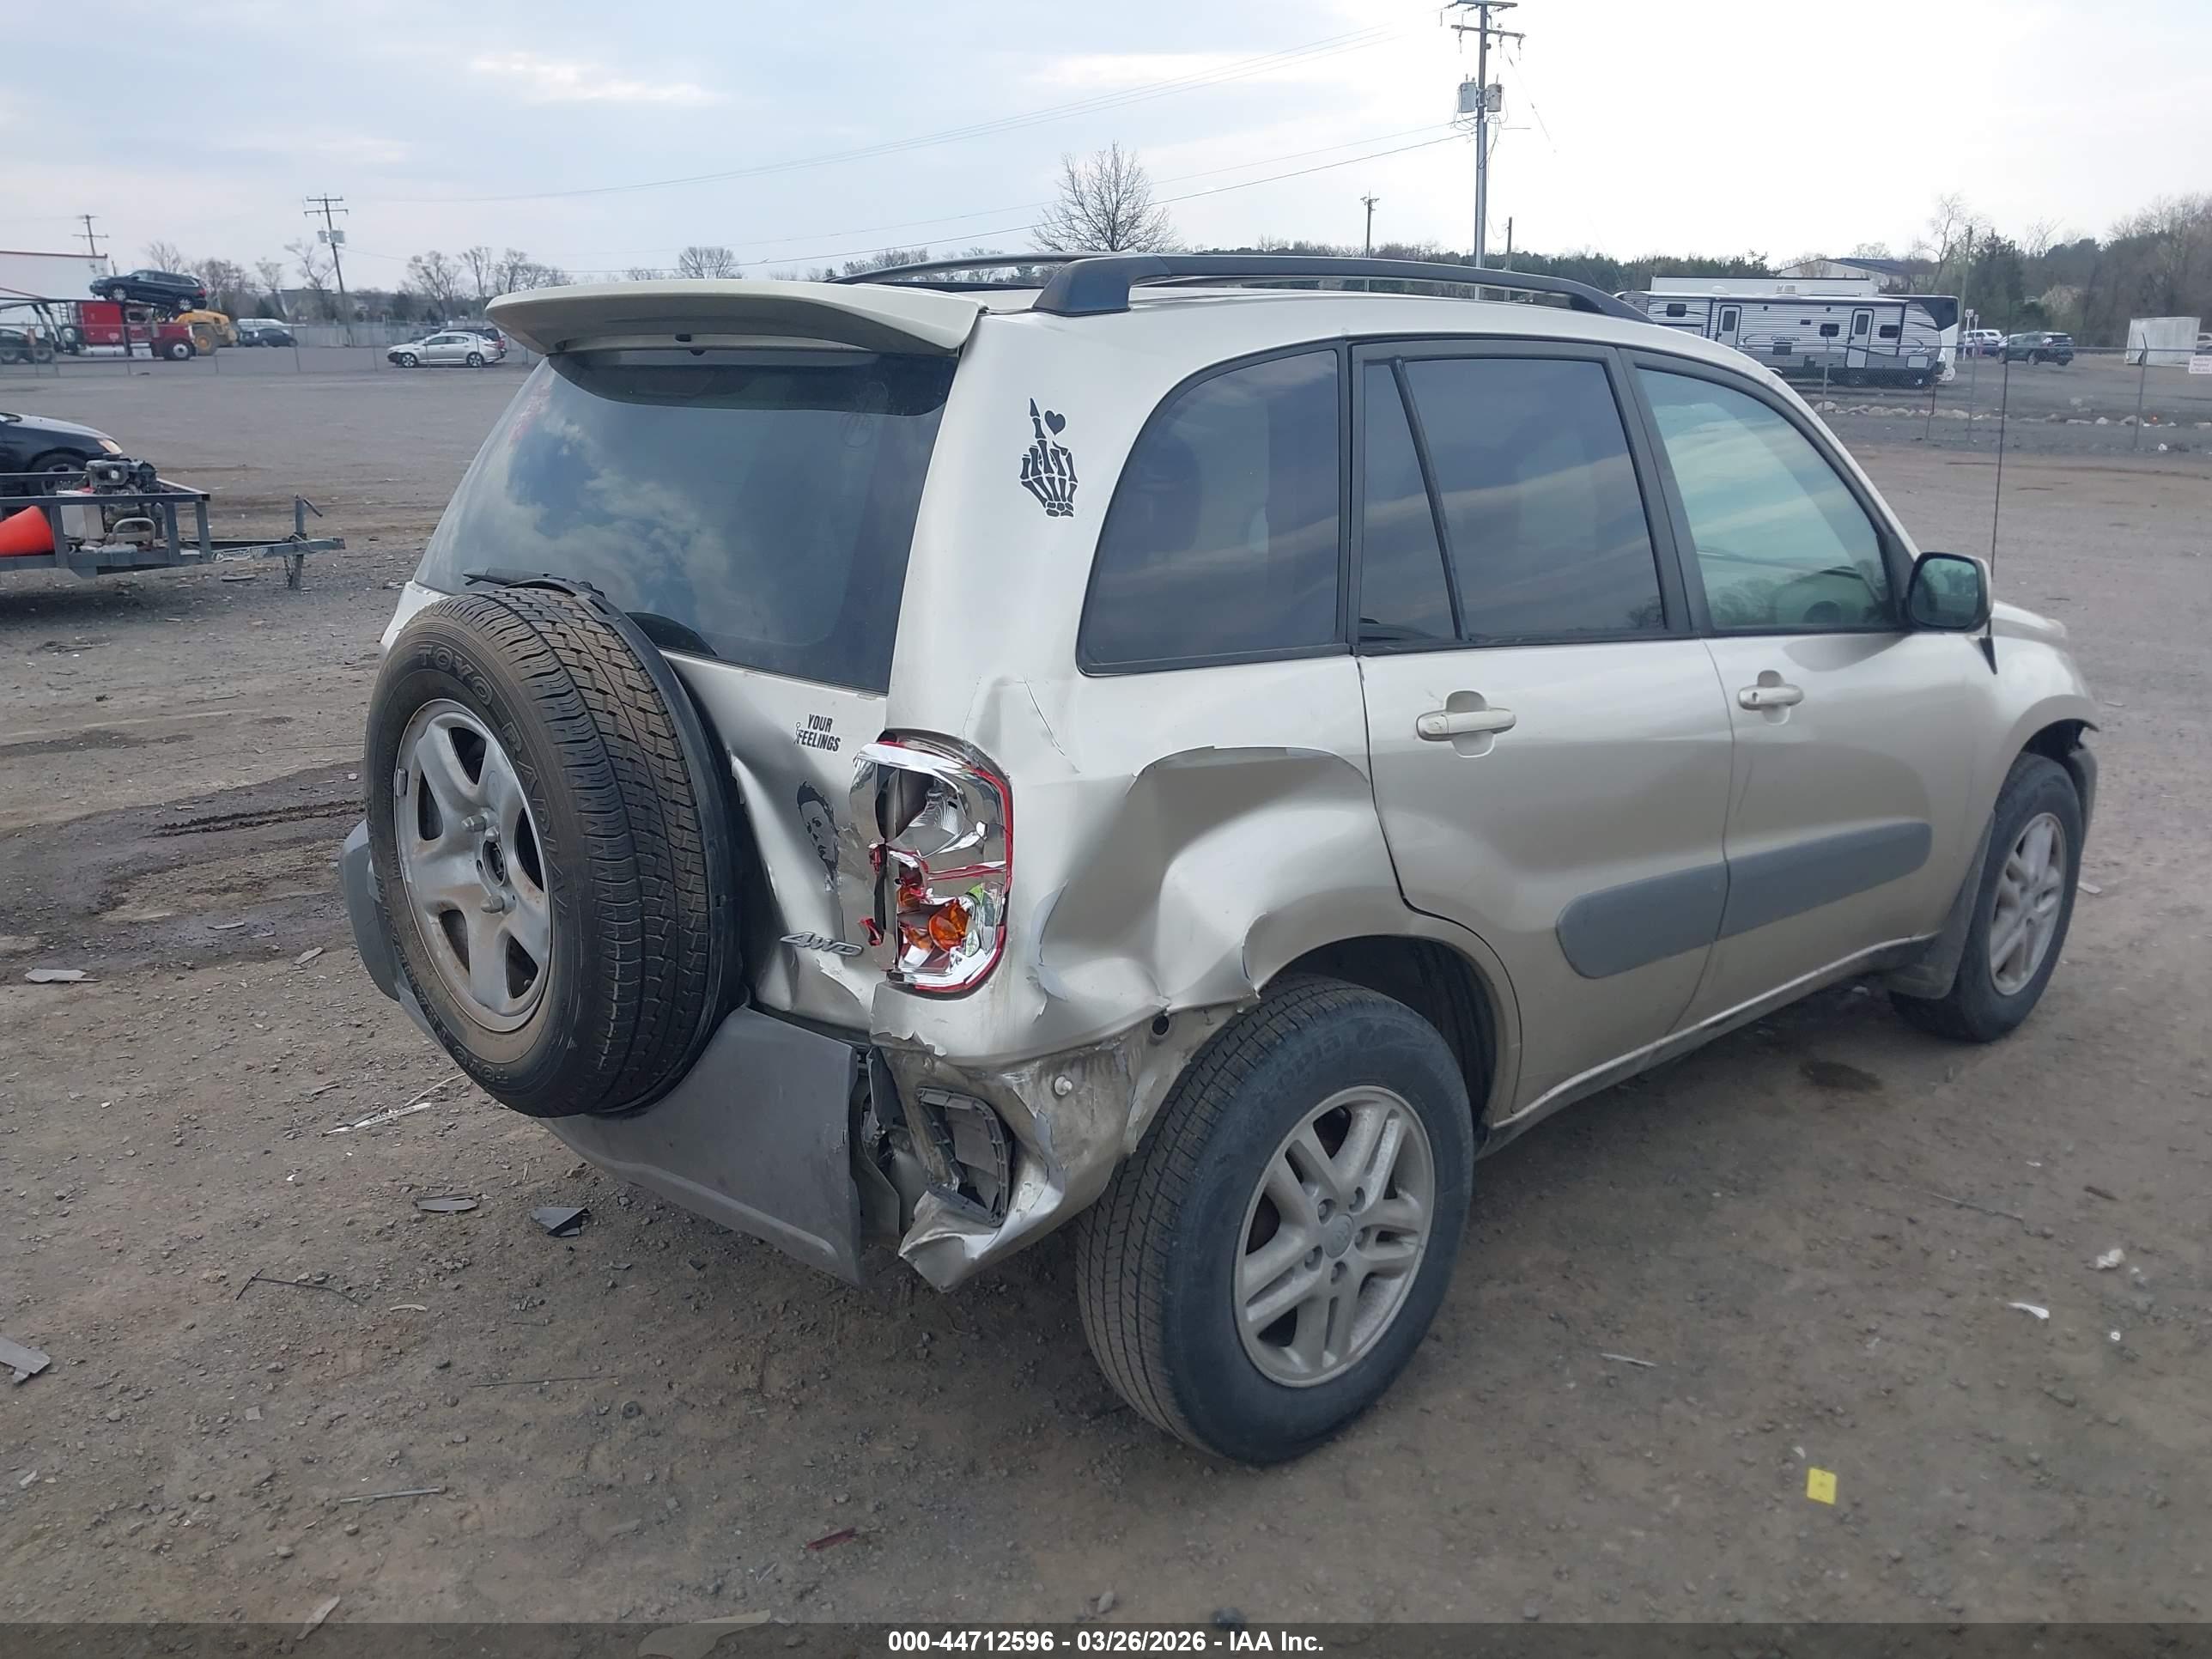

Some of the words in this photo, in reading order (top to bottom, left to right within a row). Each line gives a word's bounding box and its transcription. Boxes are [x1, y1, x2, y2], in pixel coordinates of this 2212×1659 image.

[418, 644, 494, 706] TOYO
[808, 714, 833, 732] YOUR
[797, 729, 841, 751] FEELINGS
[779, 932, 864, 957] 4WD
